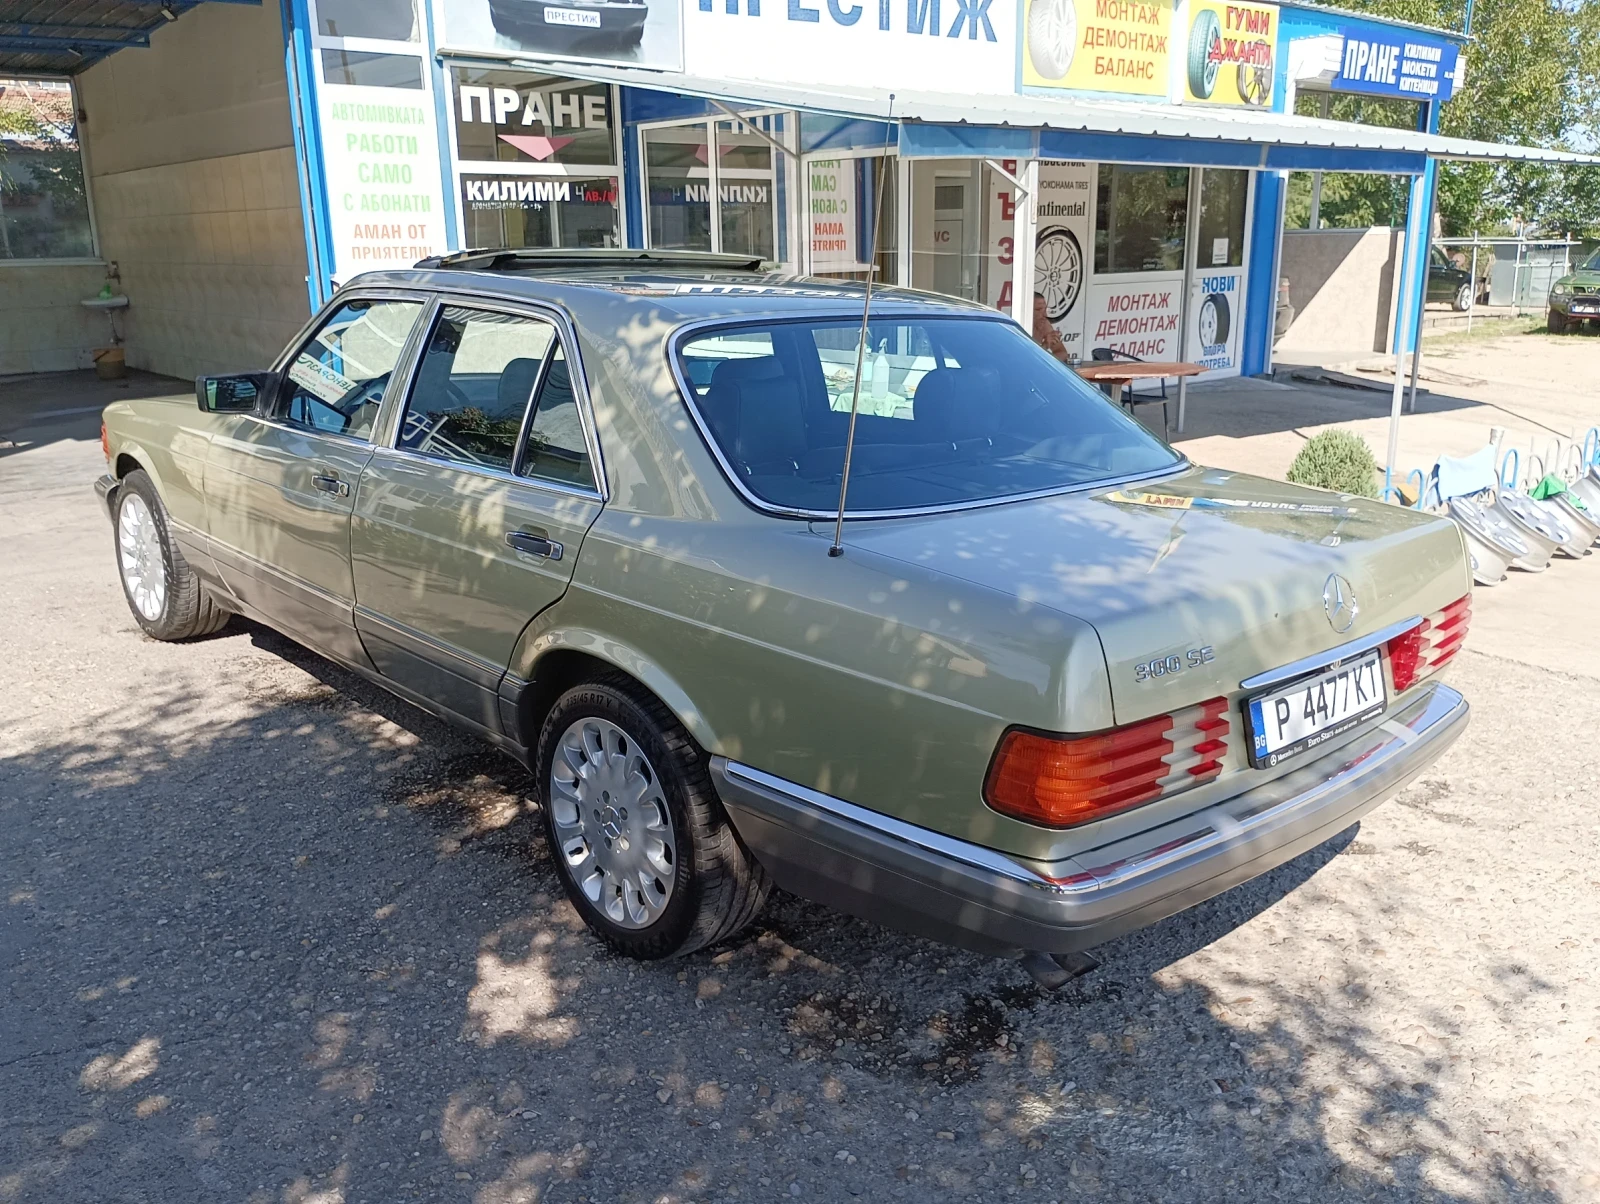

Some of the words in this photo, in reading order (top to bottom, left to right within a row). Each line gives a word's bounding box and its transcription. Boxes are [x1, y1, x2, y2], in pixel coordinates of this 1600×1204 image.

[547, 11, 598, 24] ПРЕСТИЖ
[1096, 0, 1160, 25] МОНТАЖ
[1226, 5, 1270, 35] ГУМИ
[1082, 26, 1167, 54] ДЕМОНТАЖ
[1208, 37, 1271, 67] ДЖАНТИ
[1342, 39, 1400, 85] ПРАНЕ
[1403, 42, 1442, 62] КИЛИМИ
[1094, 56, 1154, 80] БАЛАНС
[1401, 60, 1438, 78] МОКЕТИ
[332, 102, 425, 124] АВТОМИВКАТА
[459, 86, 607, 129] ПРАНЕ
[346, 133, 418, 155] РАБОТИ
[358, 162, 412, 184] САМО
[466, 181, 571, 202] КИЛИМИ
[361, 193, 431, 213] АБОНАТИ
[354, 224, 401, 239] АМАН
[407, 224, 427, 239] ОТ
[1202, 276, 1236, 293] НОВИ
[1107, 292, 1171, 313] МОНТАЖ
[1095, 314, 1179, 341] ДЕМОНТАЖ
[1134, 654, 1181, 683] 300
[1187, 646, 1216, 668] SE
[1275, 698, 1290, 740] P
[1304, 671, 1349, 726] 4477
[1353, 659, 1376, 705] KT
[1255, 734, 1266, 749] BG
